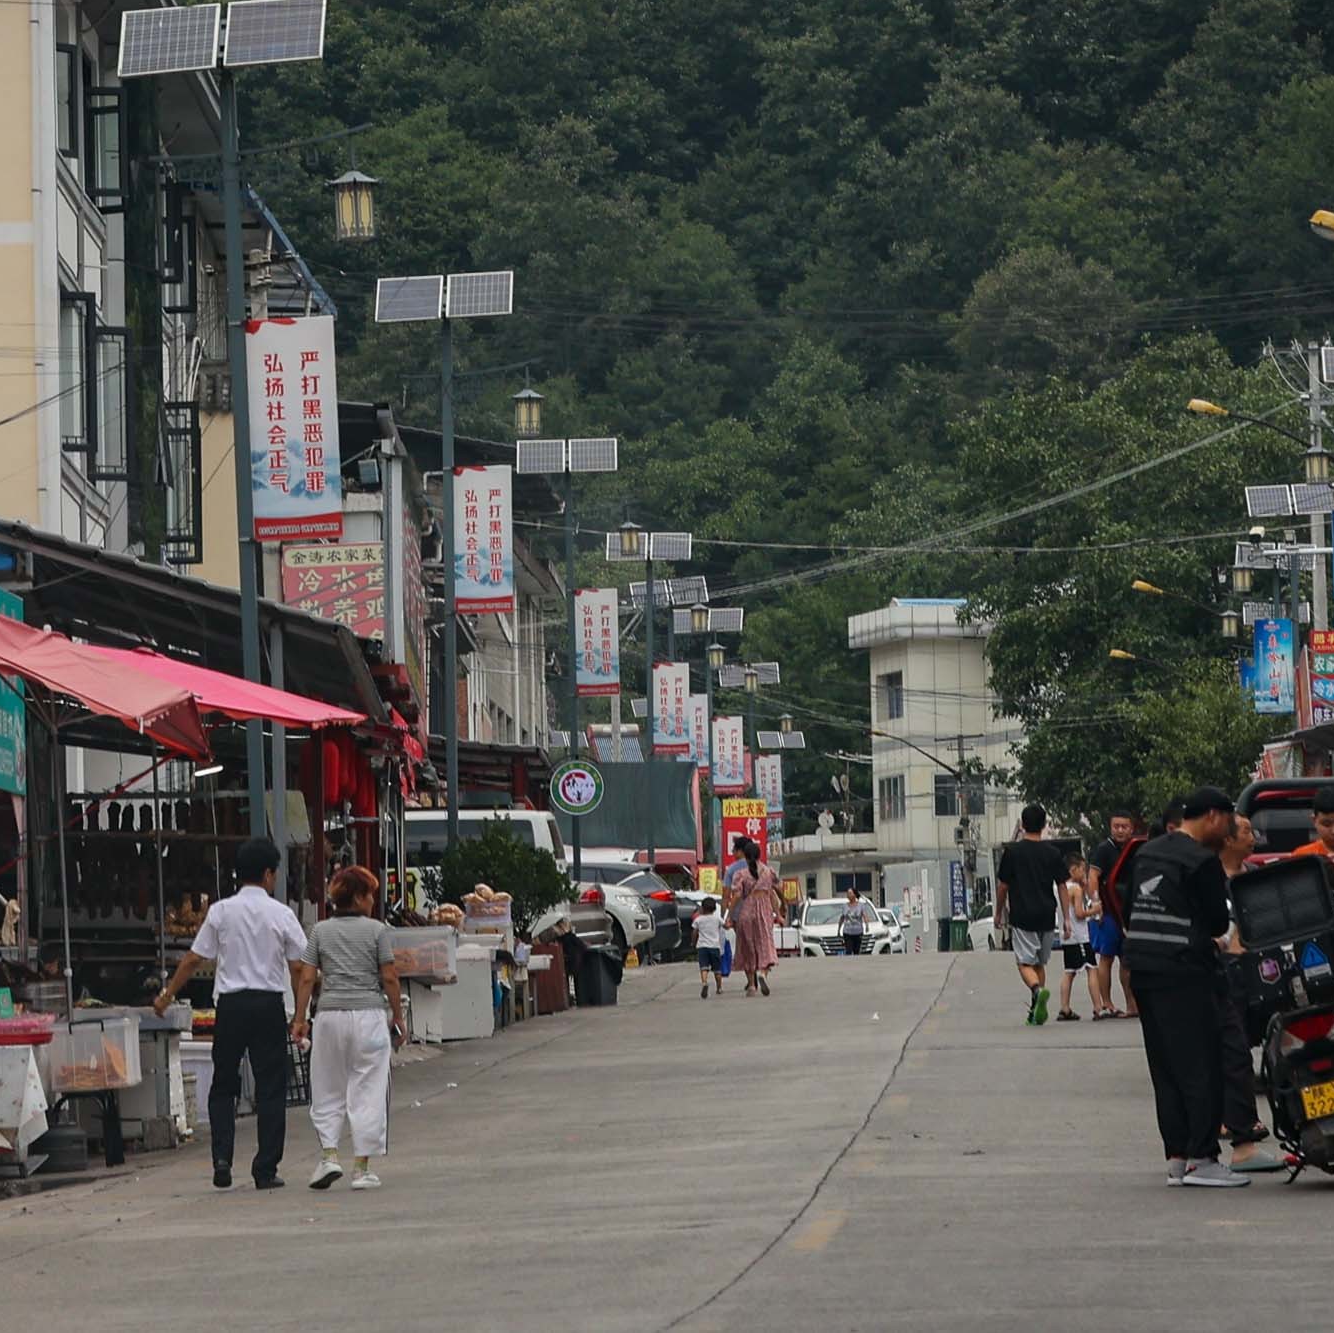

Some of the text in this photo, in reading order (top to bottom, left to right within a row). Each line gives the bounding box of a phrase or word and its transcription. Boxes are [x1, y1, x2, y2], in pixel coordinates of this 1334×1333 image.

[264, 353, 290, 494] 弘扬社会正气
[300, 350, 326, 492] 严打黑恶犯罪
[464, 488, 480, 583] 弘扬社会正气
[488, 488, 504, 583] 严打黑恶犯罪
[583, 604, 596, 674] 弘扬社会正气
[600, 604, 612, 675] 严打黑恶犯罪
